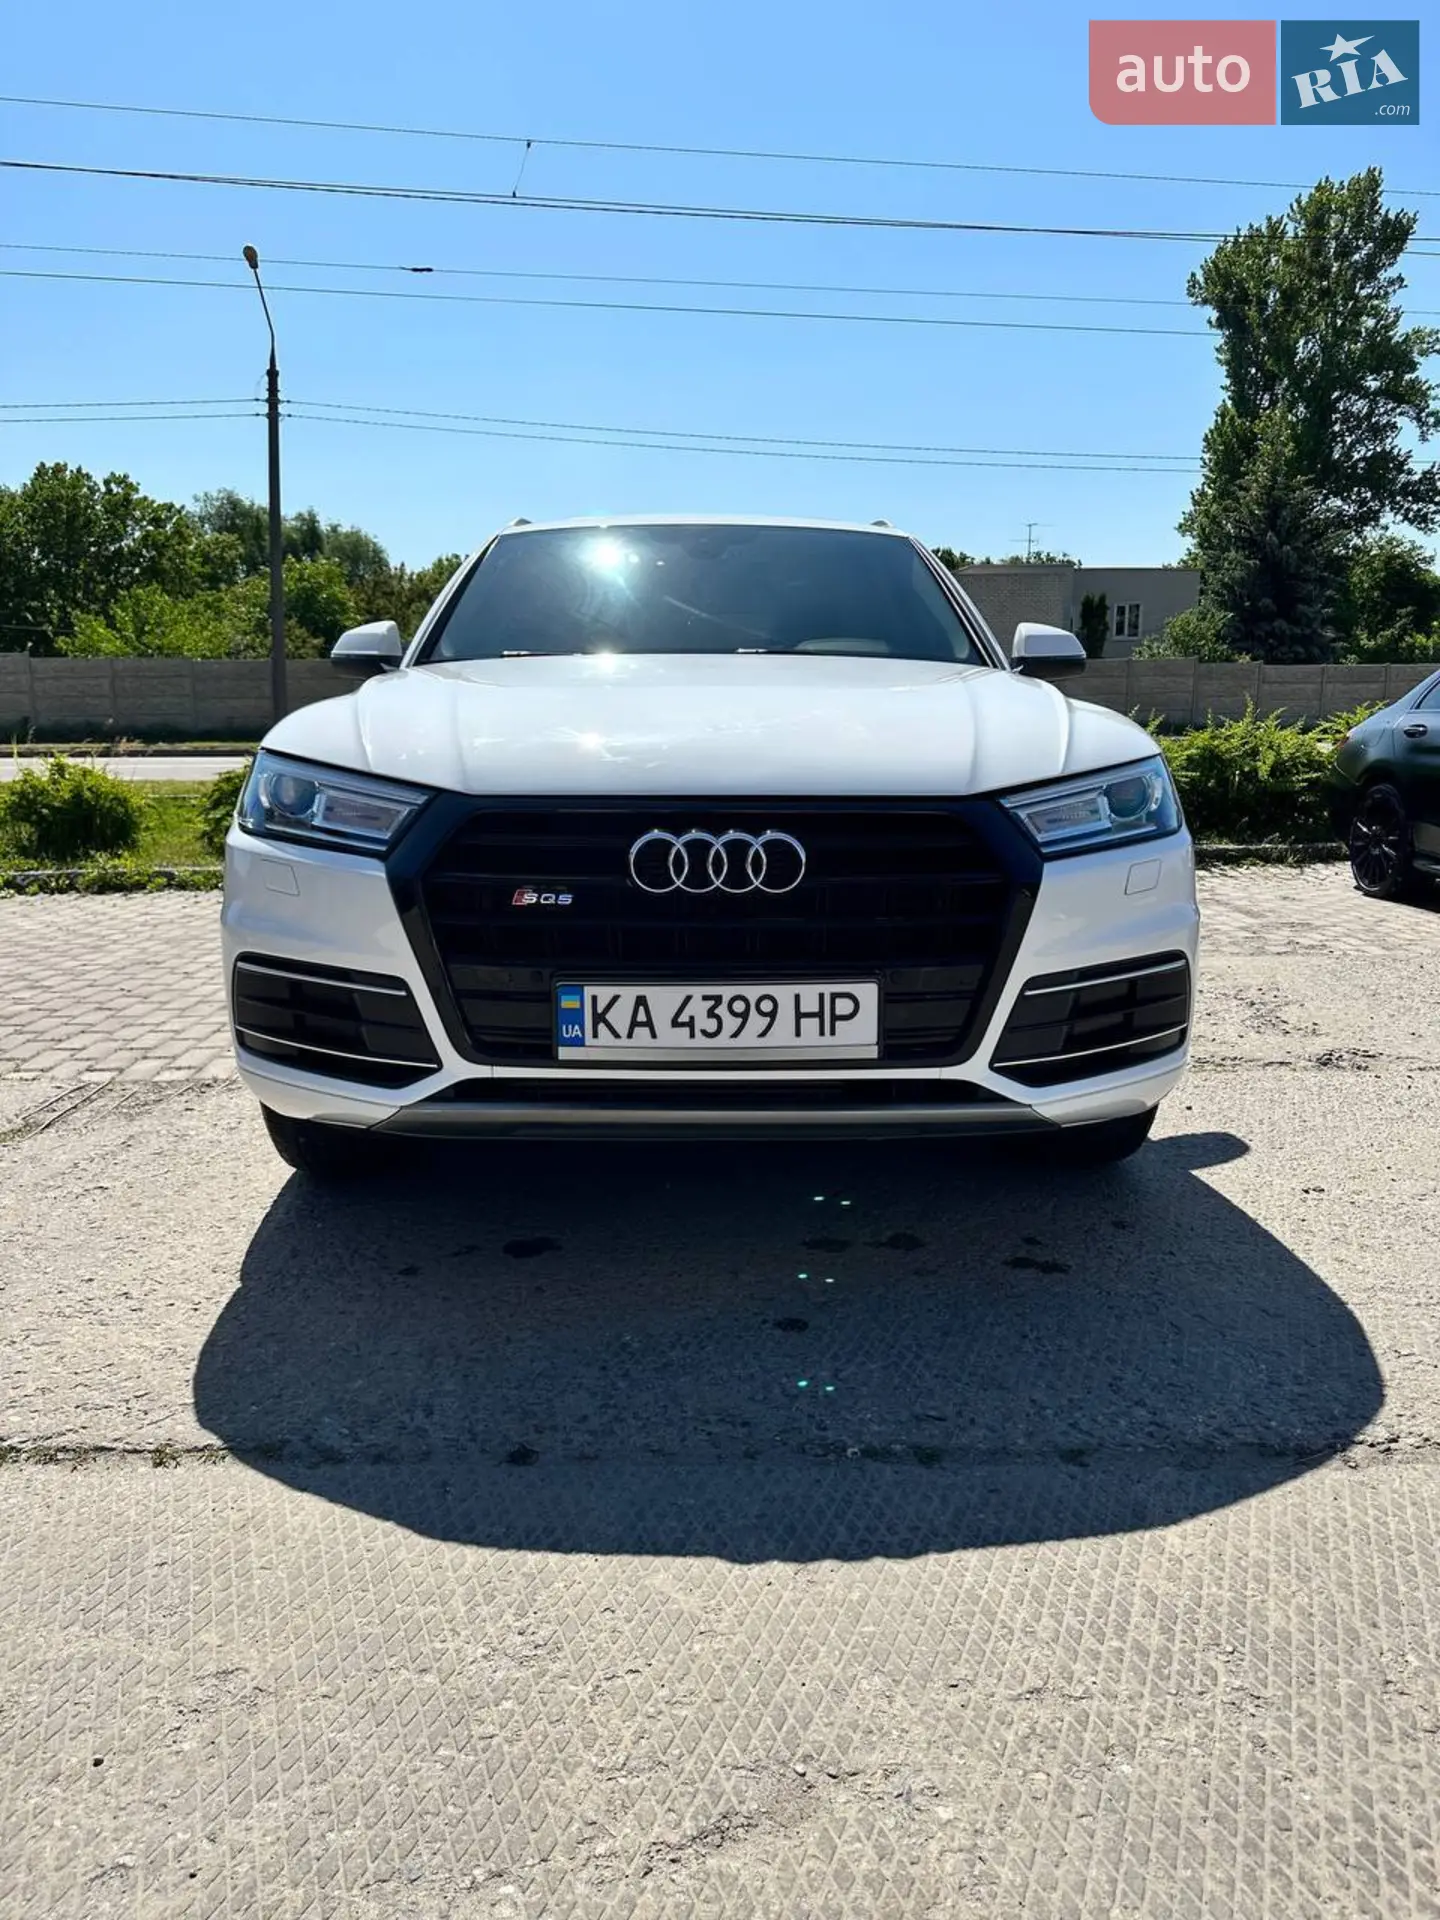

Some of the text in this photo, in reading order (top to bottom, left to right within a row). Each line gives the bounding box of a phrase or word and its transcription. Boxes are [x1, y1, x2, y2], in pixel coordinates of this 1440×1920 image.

[515, 890, 574, 905] SQ5
[590, 992, 861, 1040] KA 4399 HP
[561, 1024, 583, 1038] UA
